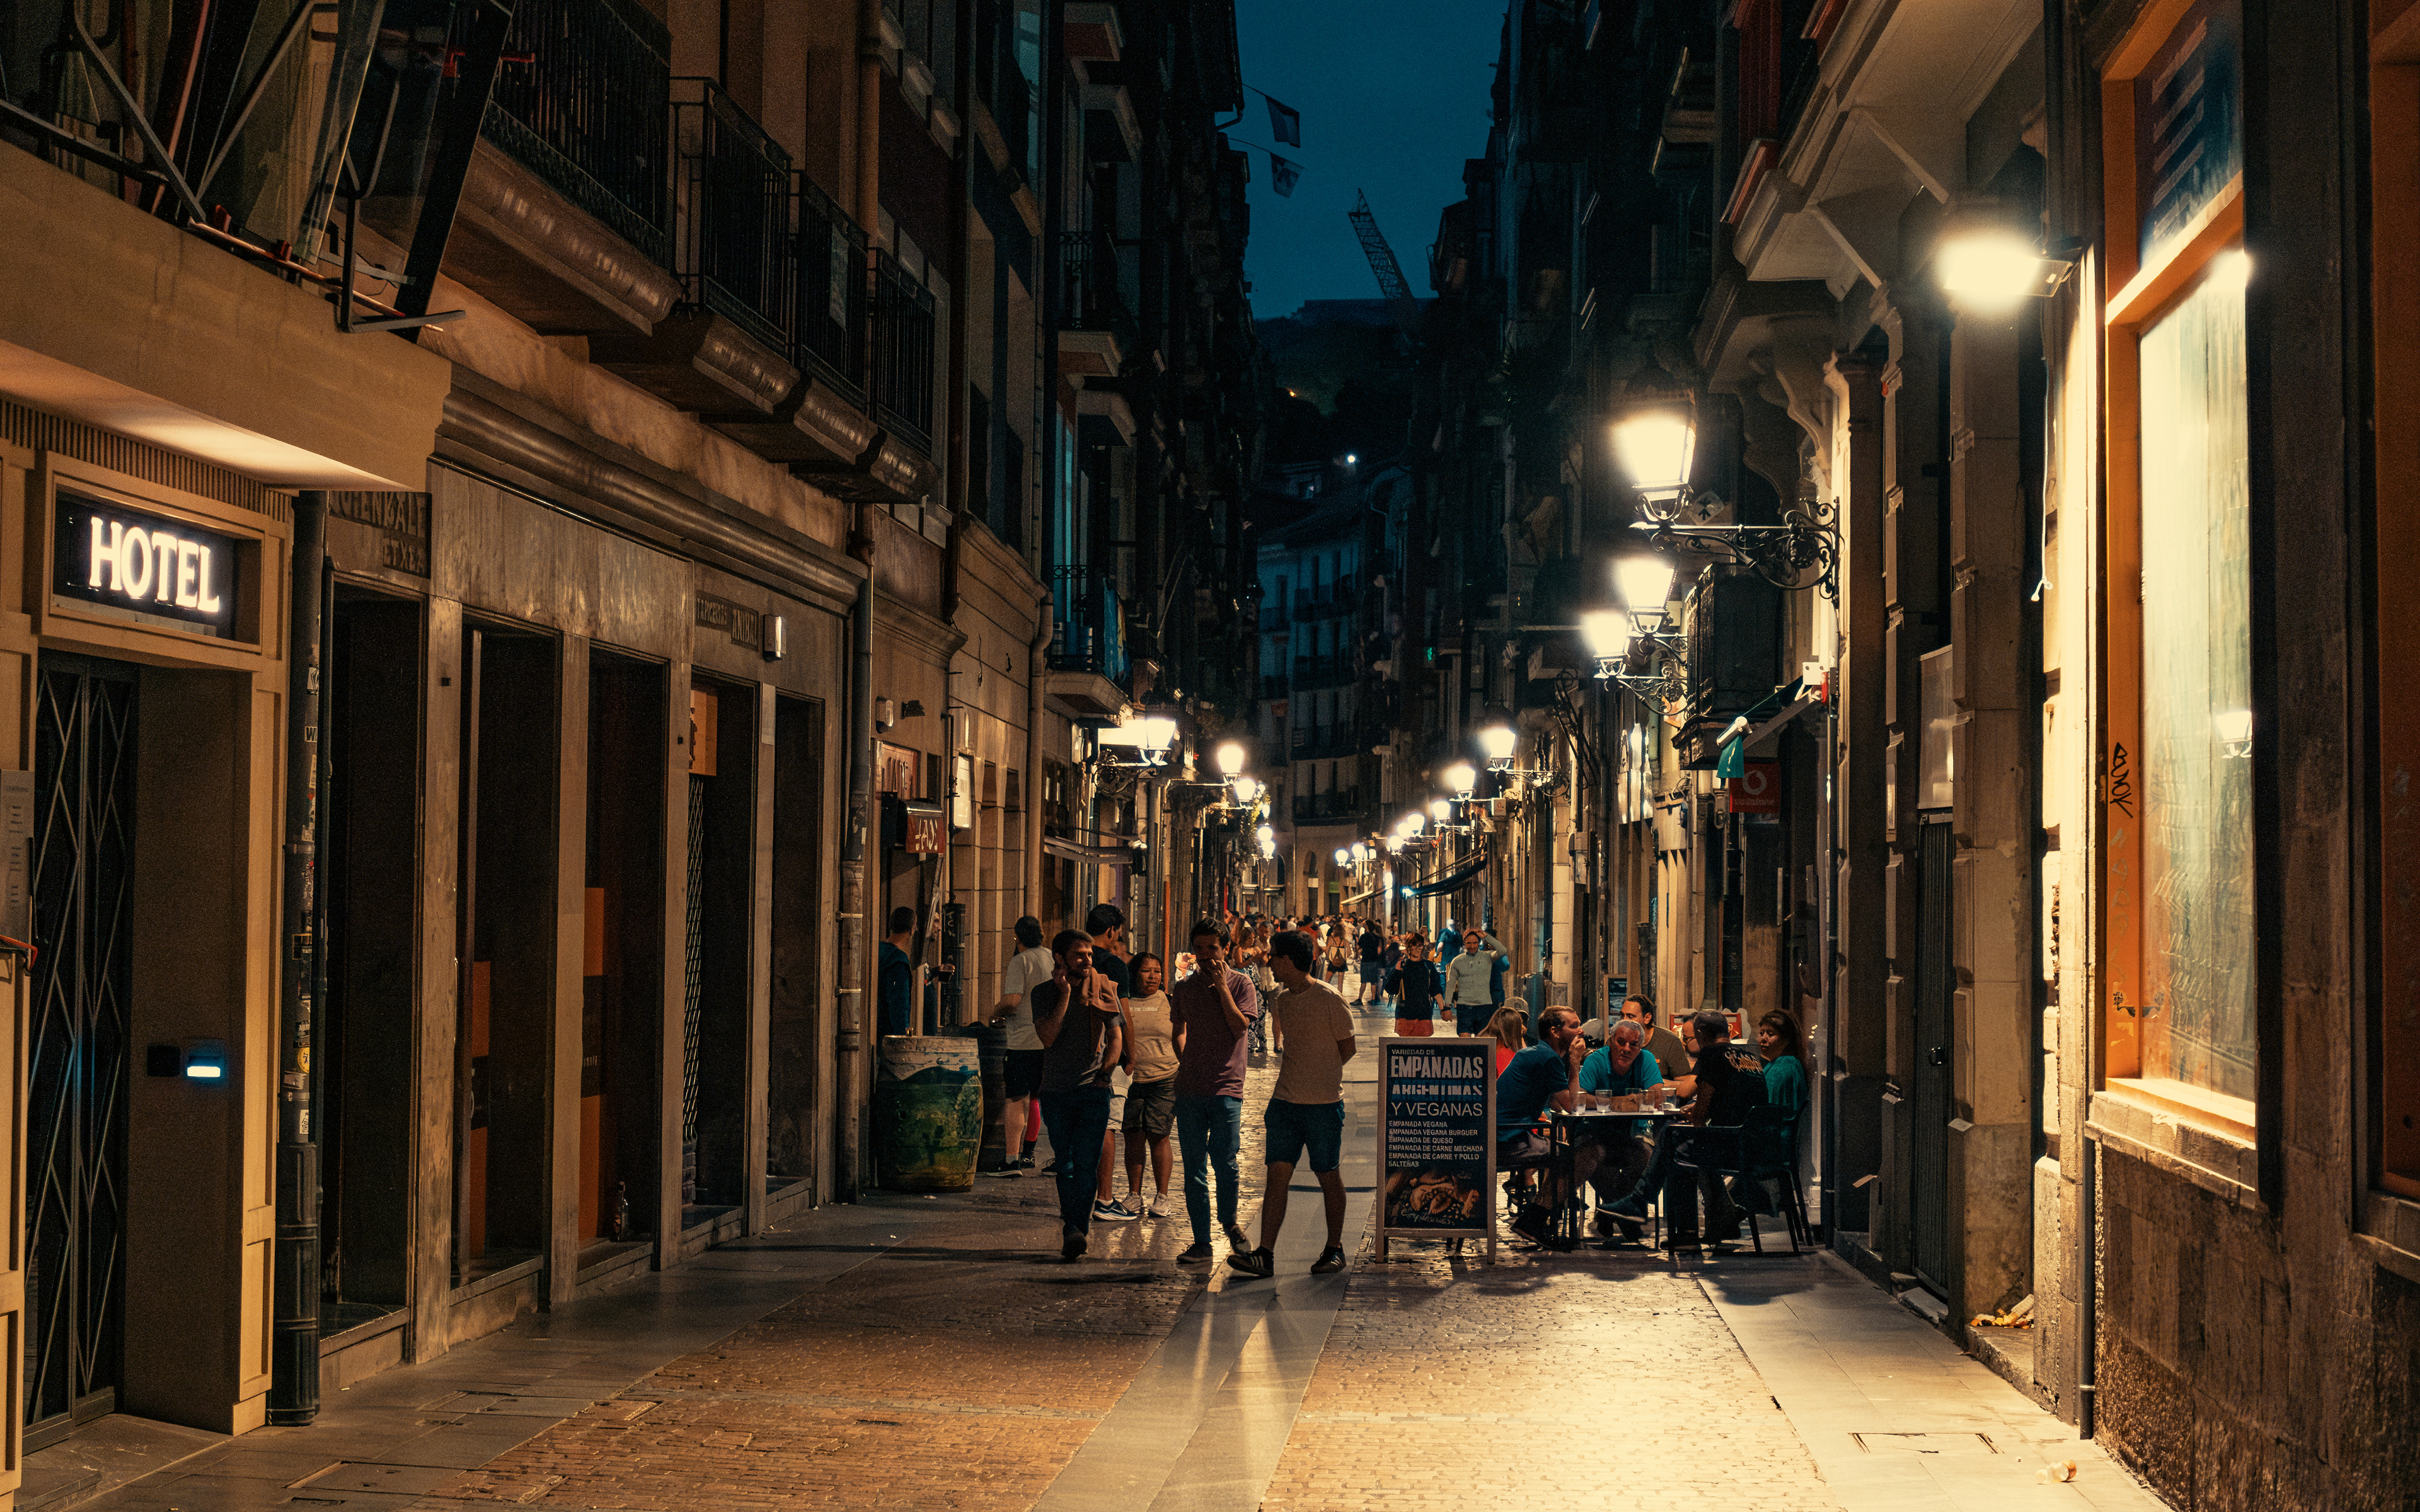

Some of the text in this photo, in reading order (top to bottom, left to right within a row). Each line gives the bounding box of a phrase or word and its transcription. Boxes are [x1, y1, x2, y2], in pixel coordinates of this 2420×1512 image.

[89, 515, 219, 613] HOTEL
[1391, 1055, 1484, 1079] EMPANADAS
[1392, 1079, 1483, 1101] ARGENTINAS
[1391, 1102, 1483, 1116] Y VEGANAS
